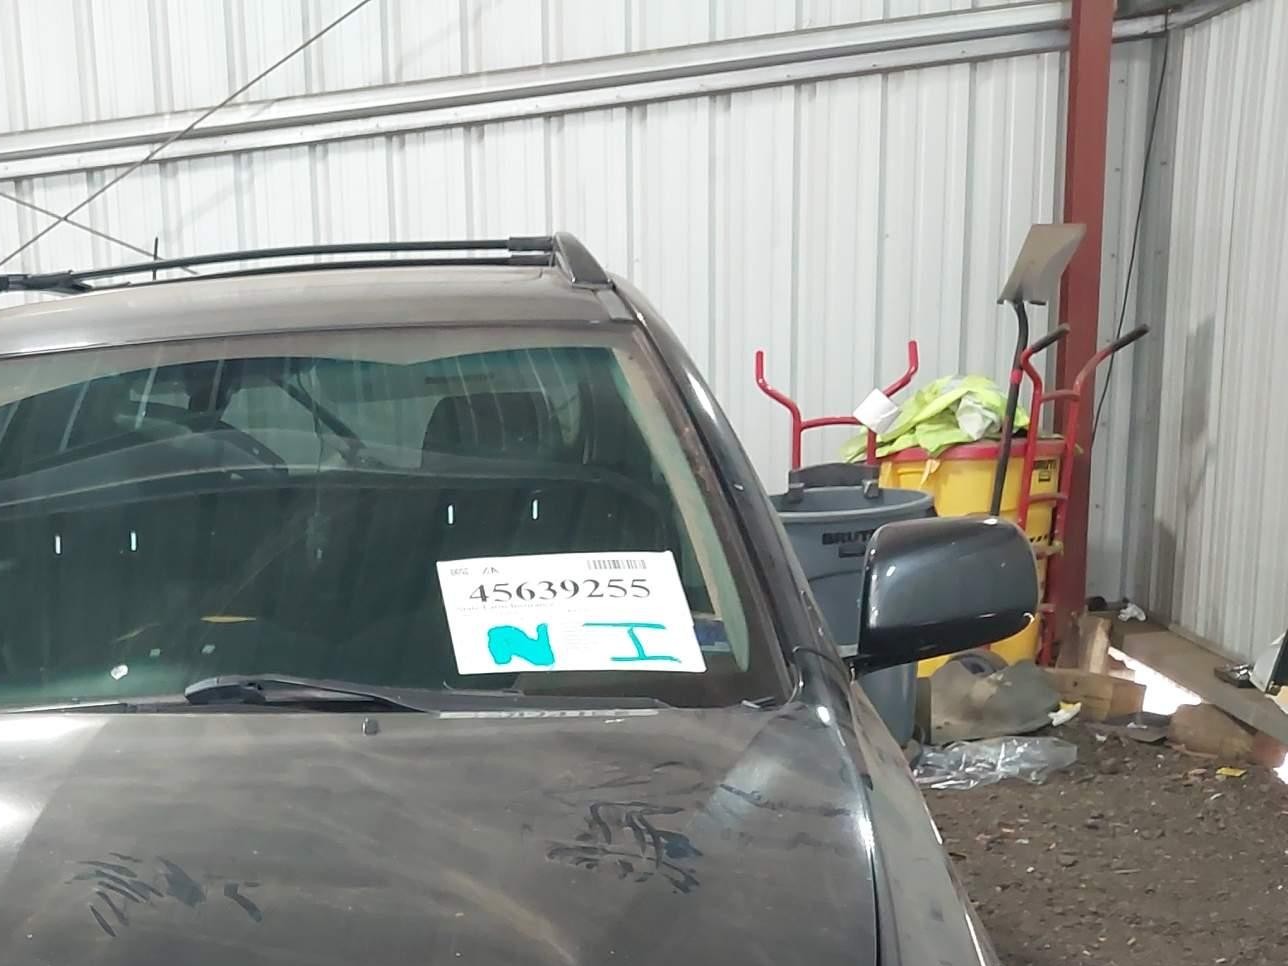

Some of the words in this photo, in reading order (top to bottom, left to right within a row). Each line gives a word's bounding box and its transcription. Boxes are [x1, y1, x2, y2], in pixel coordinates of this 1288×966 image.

[822, 529, 875, 545] BRUT
[469, 578, 651, 603] 45639255
[582, 622, 682, 663] I
